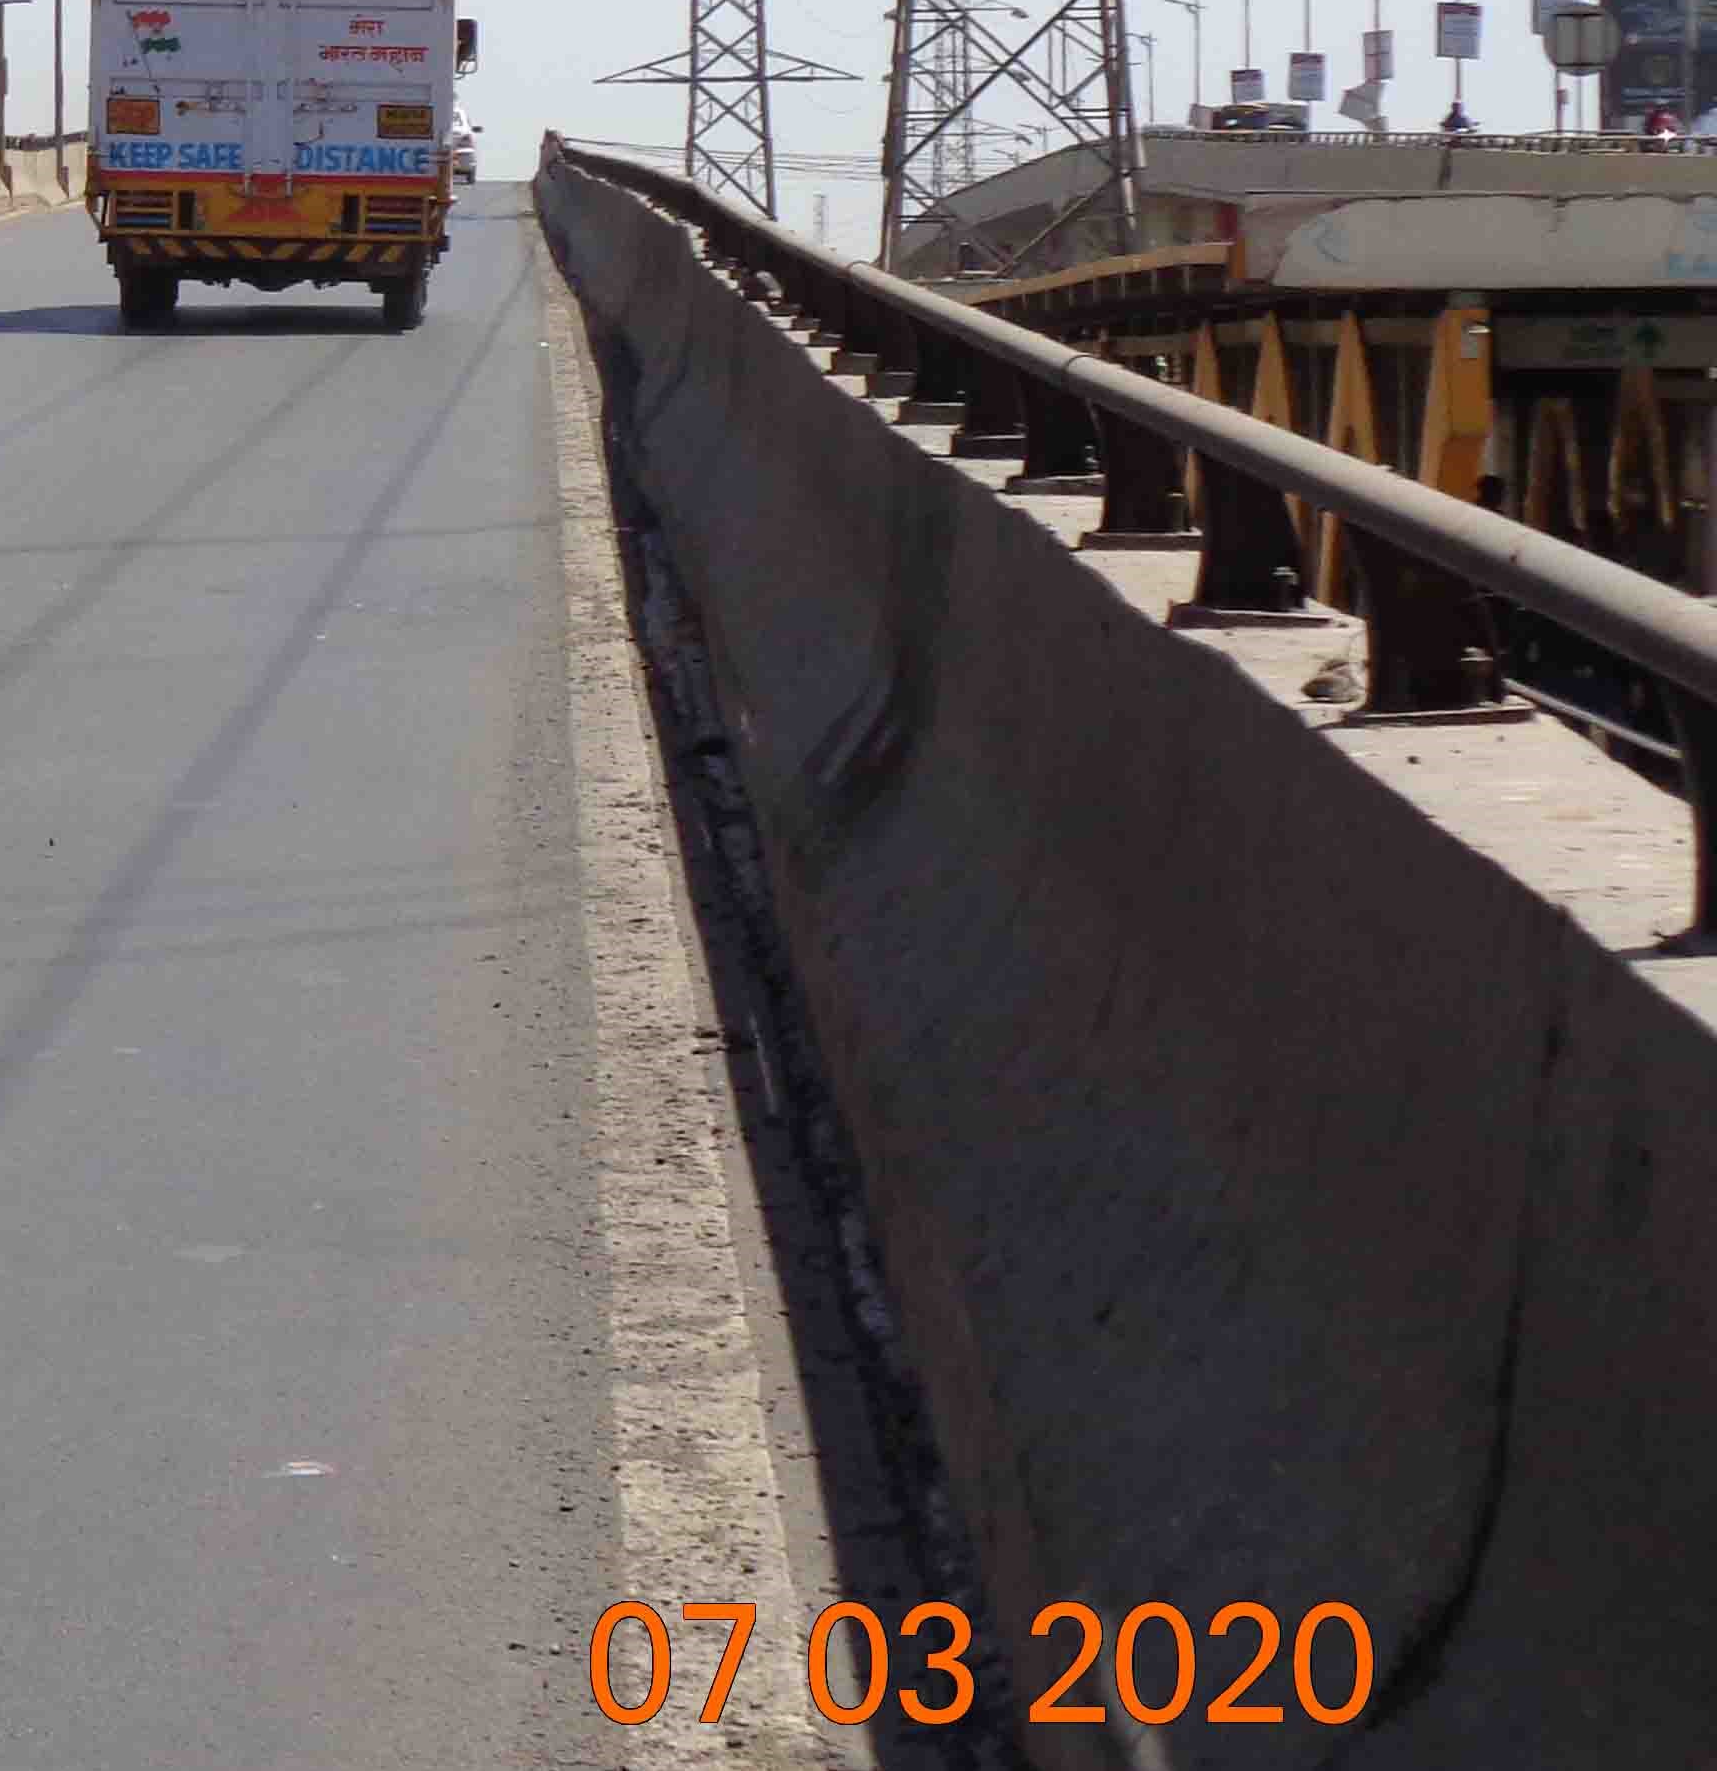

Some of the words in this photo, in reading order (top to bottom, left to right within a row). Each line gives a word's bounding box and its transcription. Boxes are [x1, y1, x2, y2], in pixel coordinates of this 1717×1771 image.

[109, 142, 174, 170] KEEP
[178, 142, 245, 171] SAFE
[294, 144, 431, 173] DISTANCE
